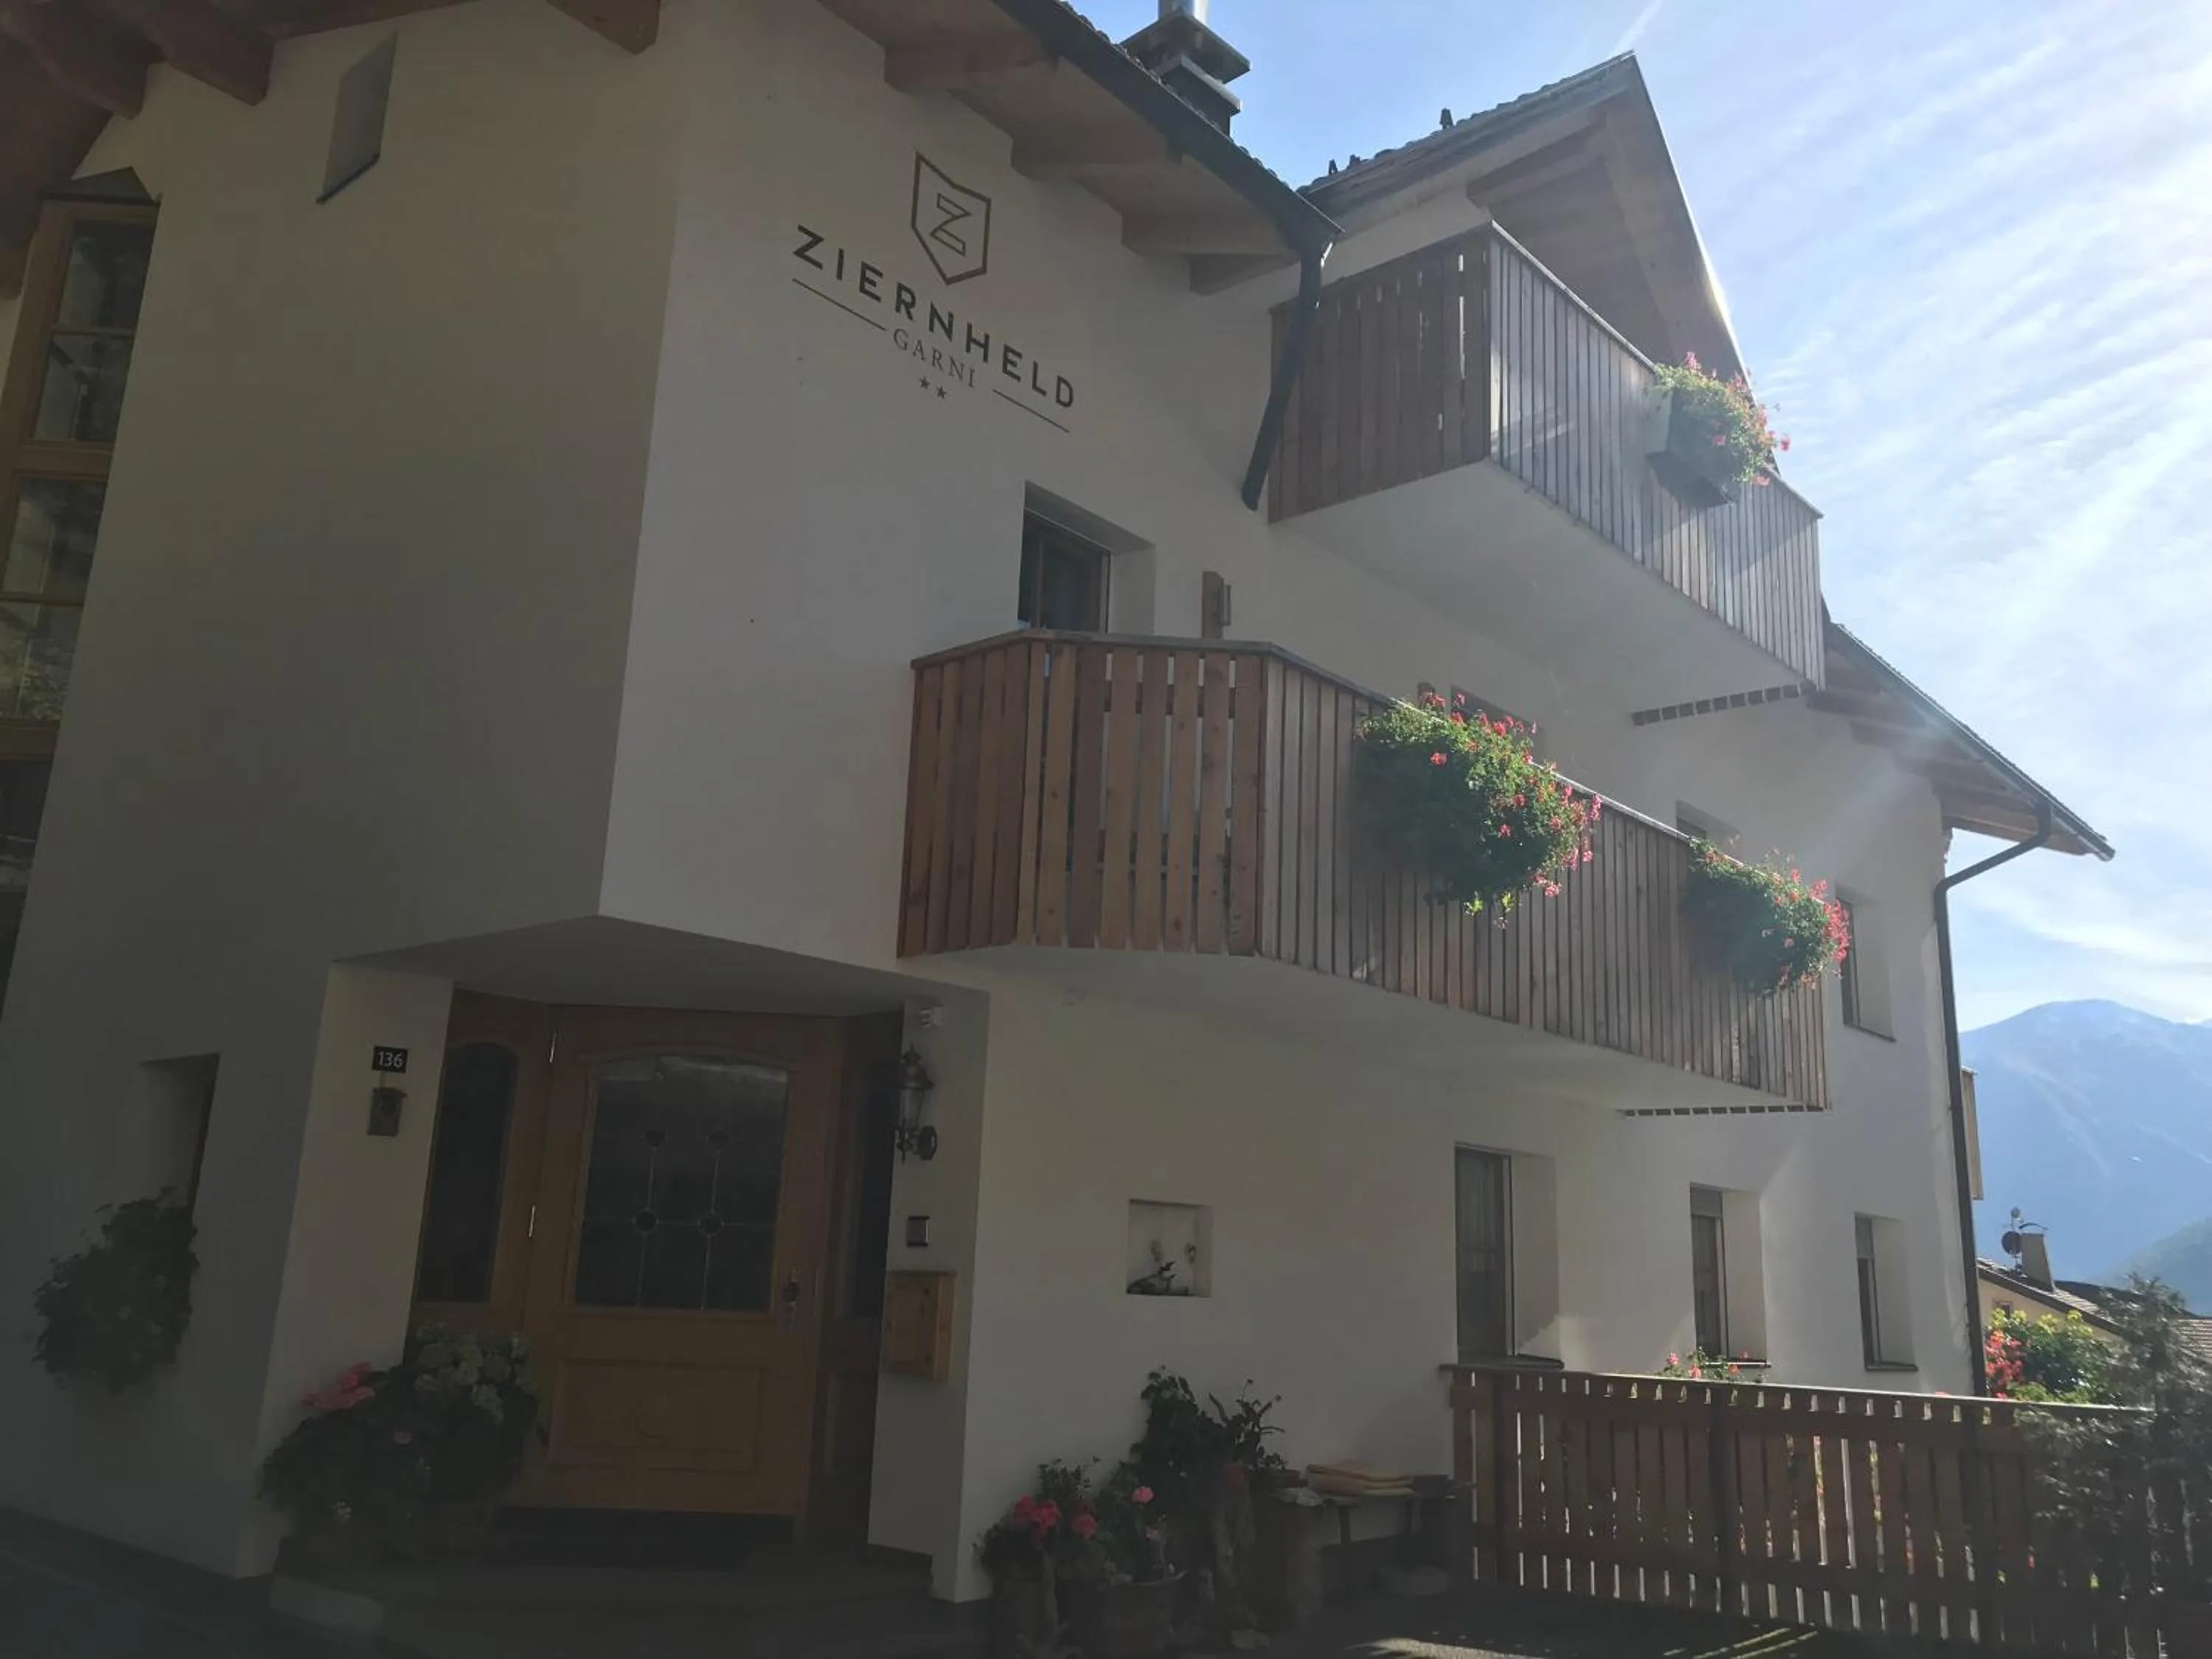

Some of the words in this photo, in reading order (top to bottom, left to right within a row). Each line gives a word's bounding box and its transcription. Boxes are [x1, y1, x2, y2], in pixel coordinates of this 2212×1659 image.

[929, 192, 972, 257] Z
[793, 224, 1074, 408] ZIERNHELD
[893, 328, 976, 388] GARNI
[378, 1051, 403, 1068] 136
